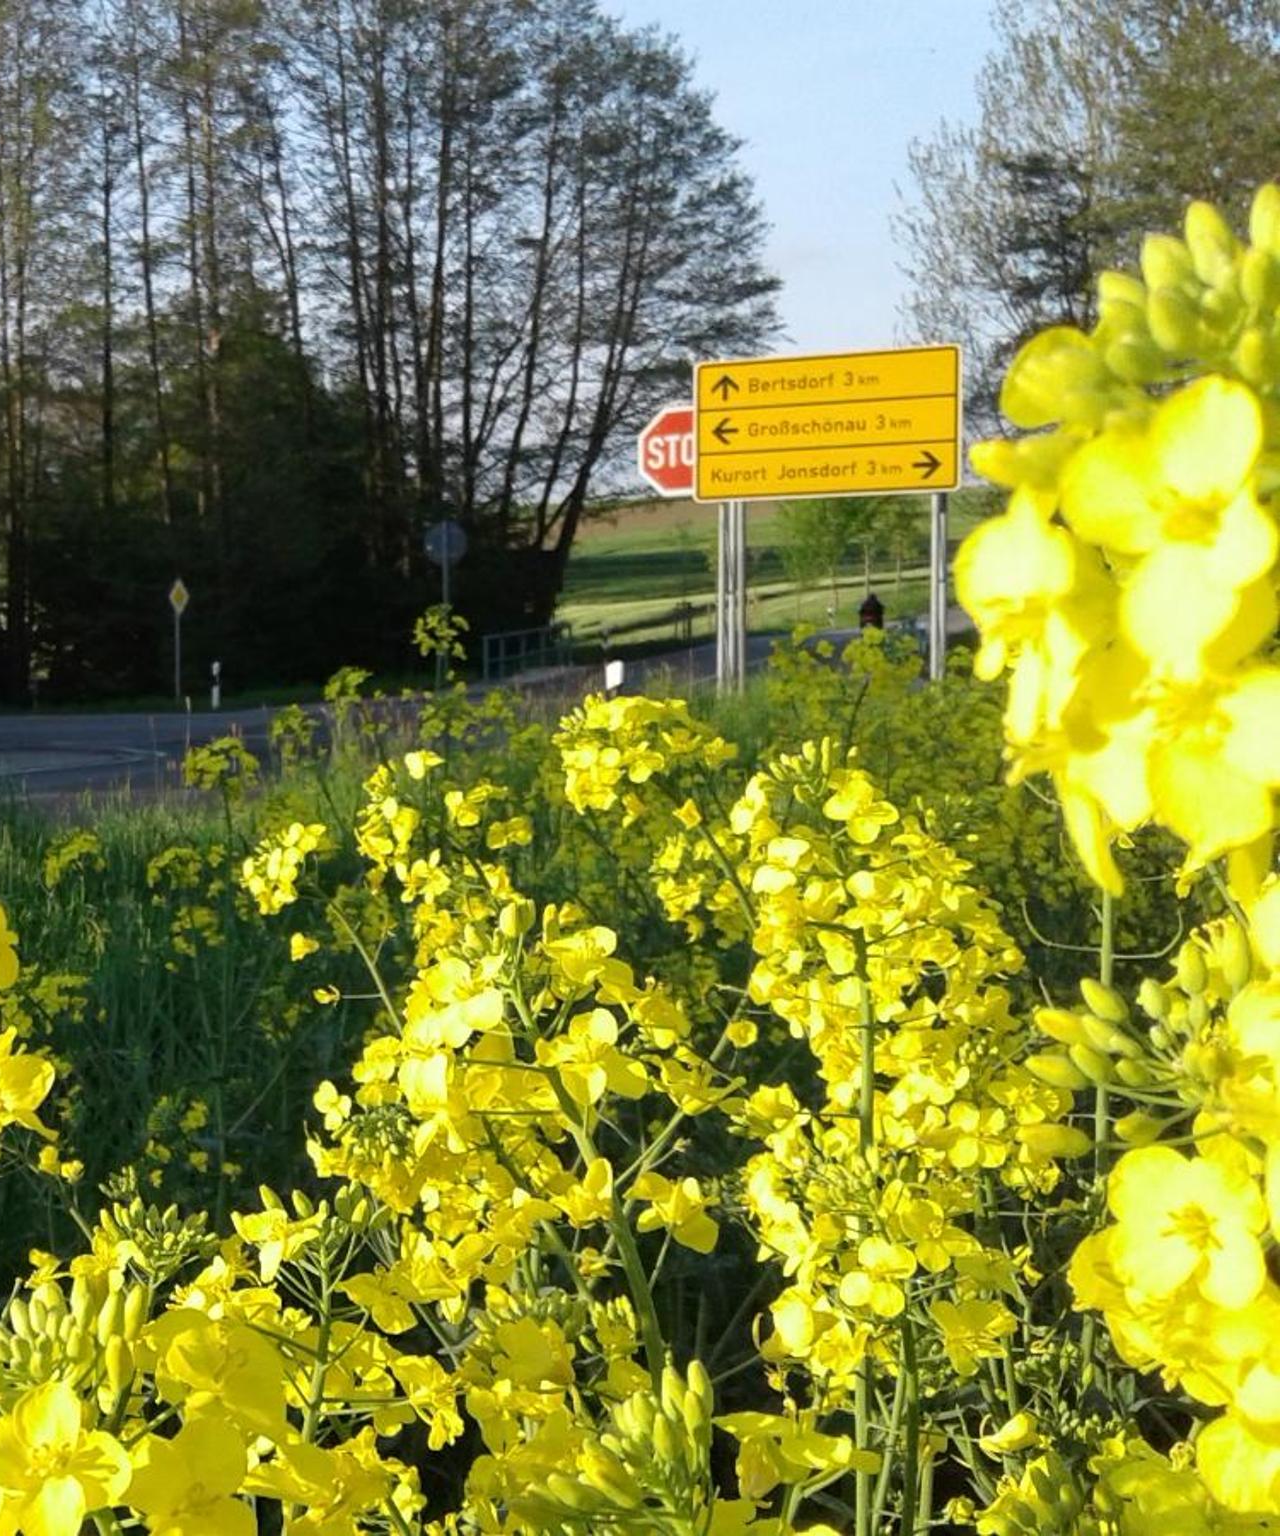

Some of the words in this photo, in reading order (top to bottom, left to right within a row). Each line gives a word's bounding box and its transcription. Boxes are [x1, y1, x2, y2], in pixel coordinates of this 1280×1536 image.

[748, 375, 834, 393] Bertsdorf
[843, 374, 854, 387] 3
[858, 374, 879, 386] km
[748, 416, 867, 437] Großschönau
[875, 415, 886, 430] 3
[890, 417, 912, 429] km
[647, 433, 693, 469] STO
[711, 466, 767, 484] Kurort
[777, 463, 856, 480] Jonsdorf
[866, 461, 877, 475] 3
[881, 463, 902, 475] km
